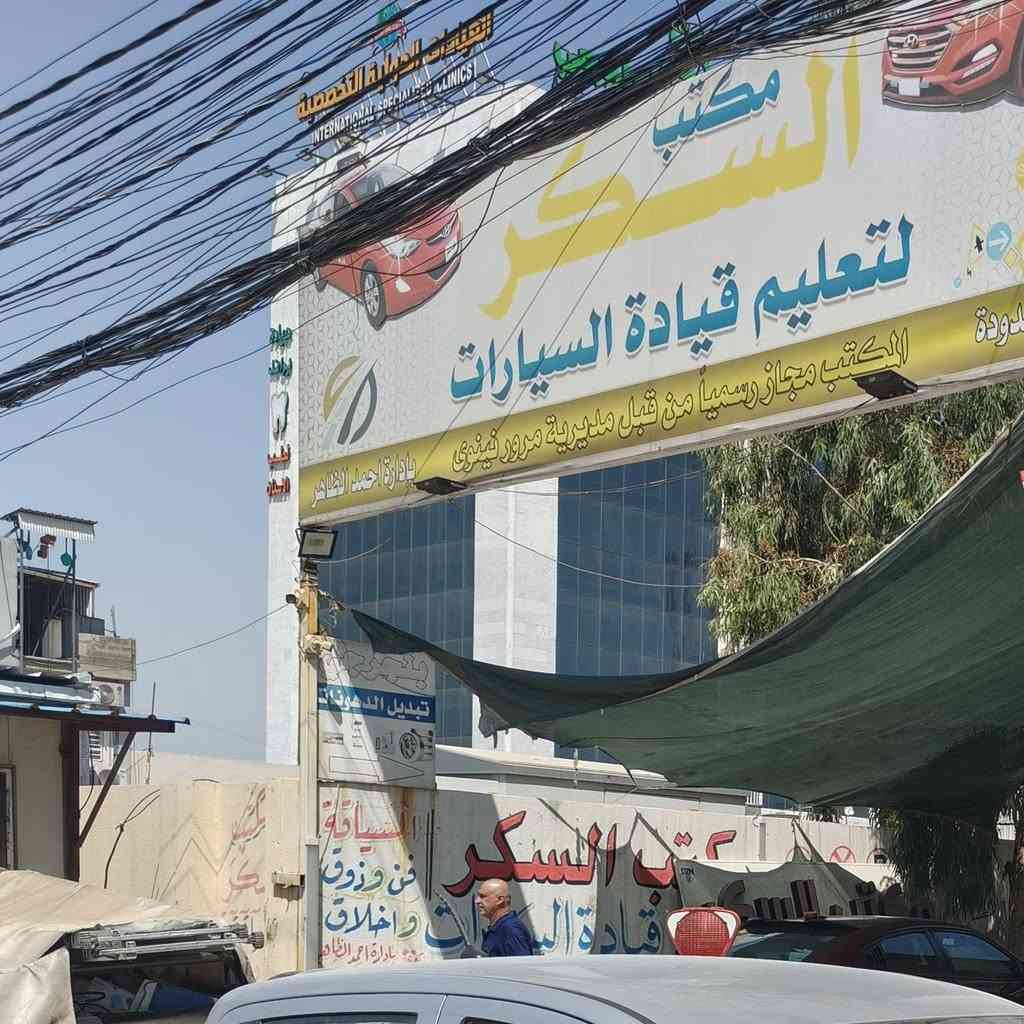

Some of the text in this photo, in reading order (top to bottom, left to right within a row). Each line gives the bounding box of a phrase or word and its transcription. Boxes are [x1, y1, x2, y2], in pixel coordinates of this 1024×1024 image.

[311, 103, 375, 146] INTERNATIONAL
[652, 62, 781, 163] مكتب
[479, 33, 861, 320] السكر
[449, 213, 914, 404] لتعليم قيادة السيارات
[759, 359, 817, 405] مجاز
[820, 327, 909, 392] المكتب
[546, 407, 616, 455] مديرية
[618, 387, 659, 440] قبل
[661, 389, 694, 431] من
[500, 427, 543, 463] مرور
[386, 697, 431, 721] تبديل
[440, 810, 617, 897] السكر
